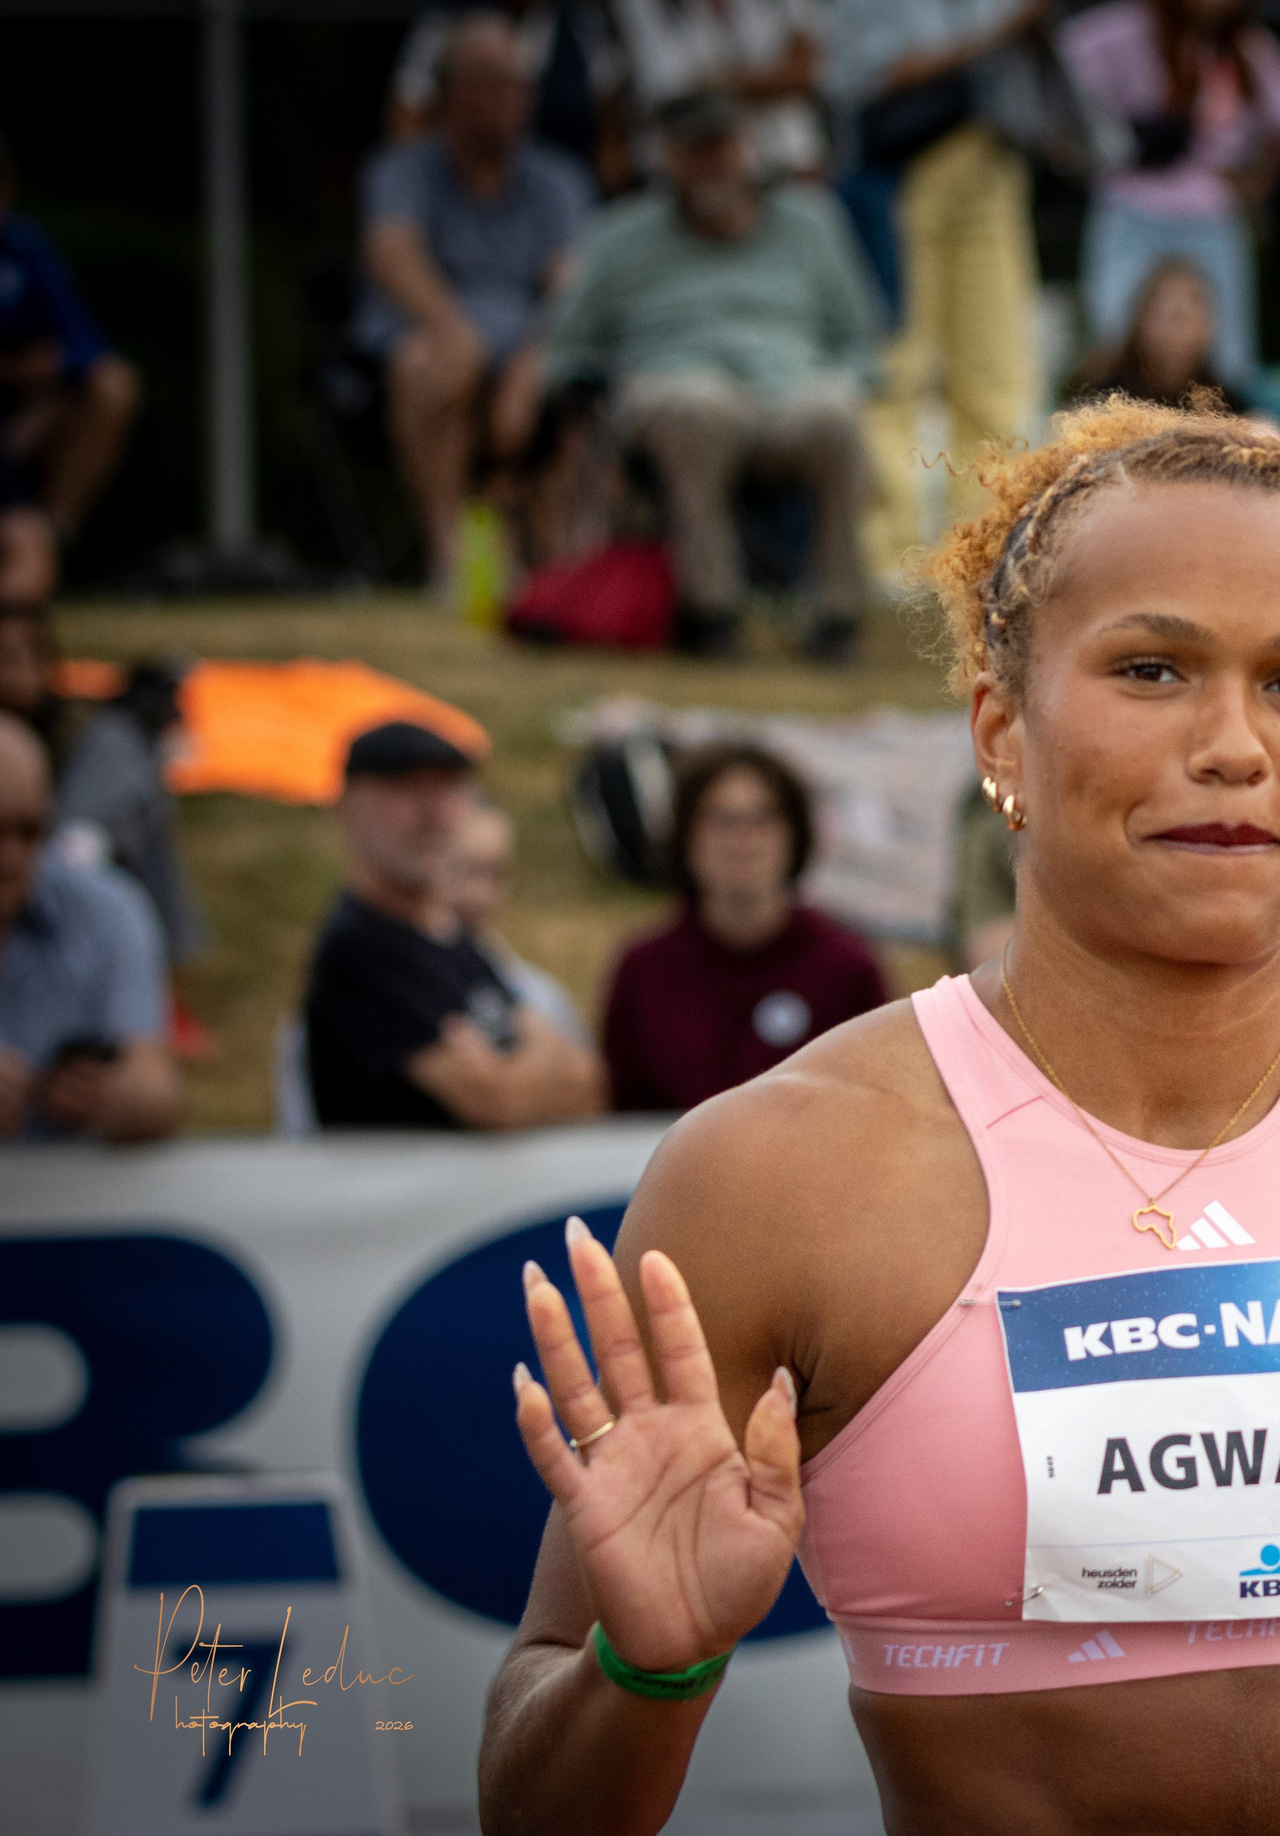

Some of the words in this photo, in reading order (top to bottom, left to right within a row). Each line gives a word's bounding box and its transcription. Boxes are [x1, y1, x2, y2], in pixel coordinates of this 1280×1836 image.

[1082, 1567, 1138, 1578] heusden
[1097, 1577, 1136, 1589] zolder
[883, 1642, 1010, 1668] TECHFIT
[172, 1634, 293, 1809] 7
